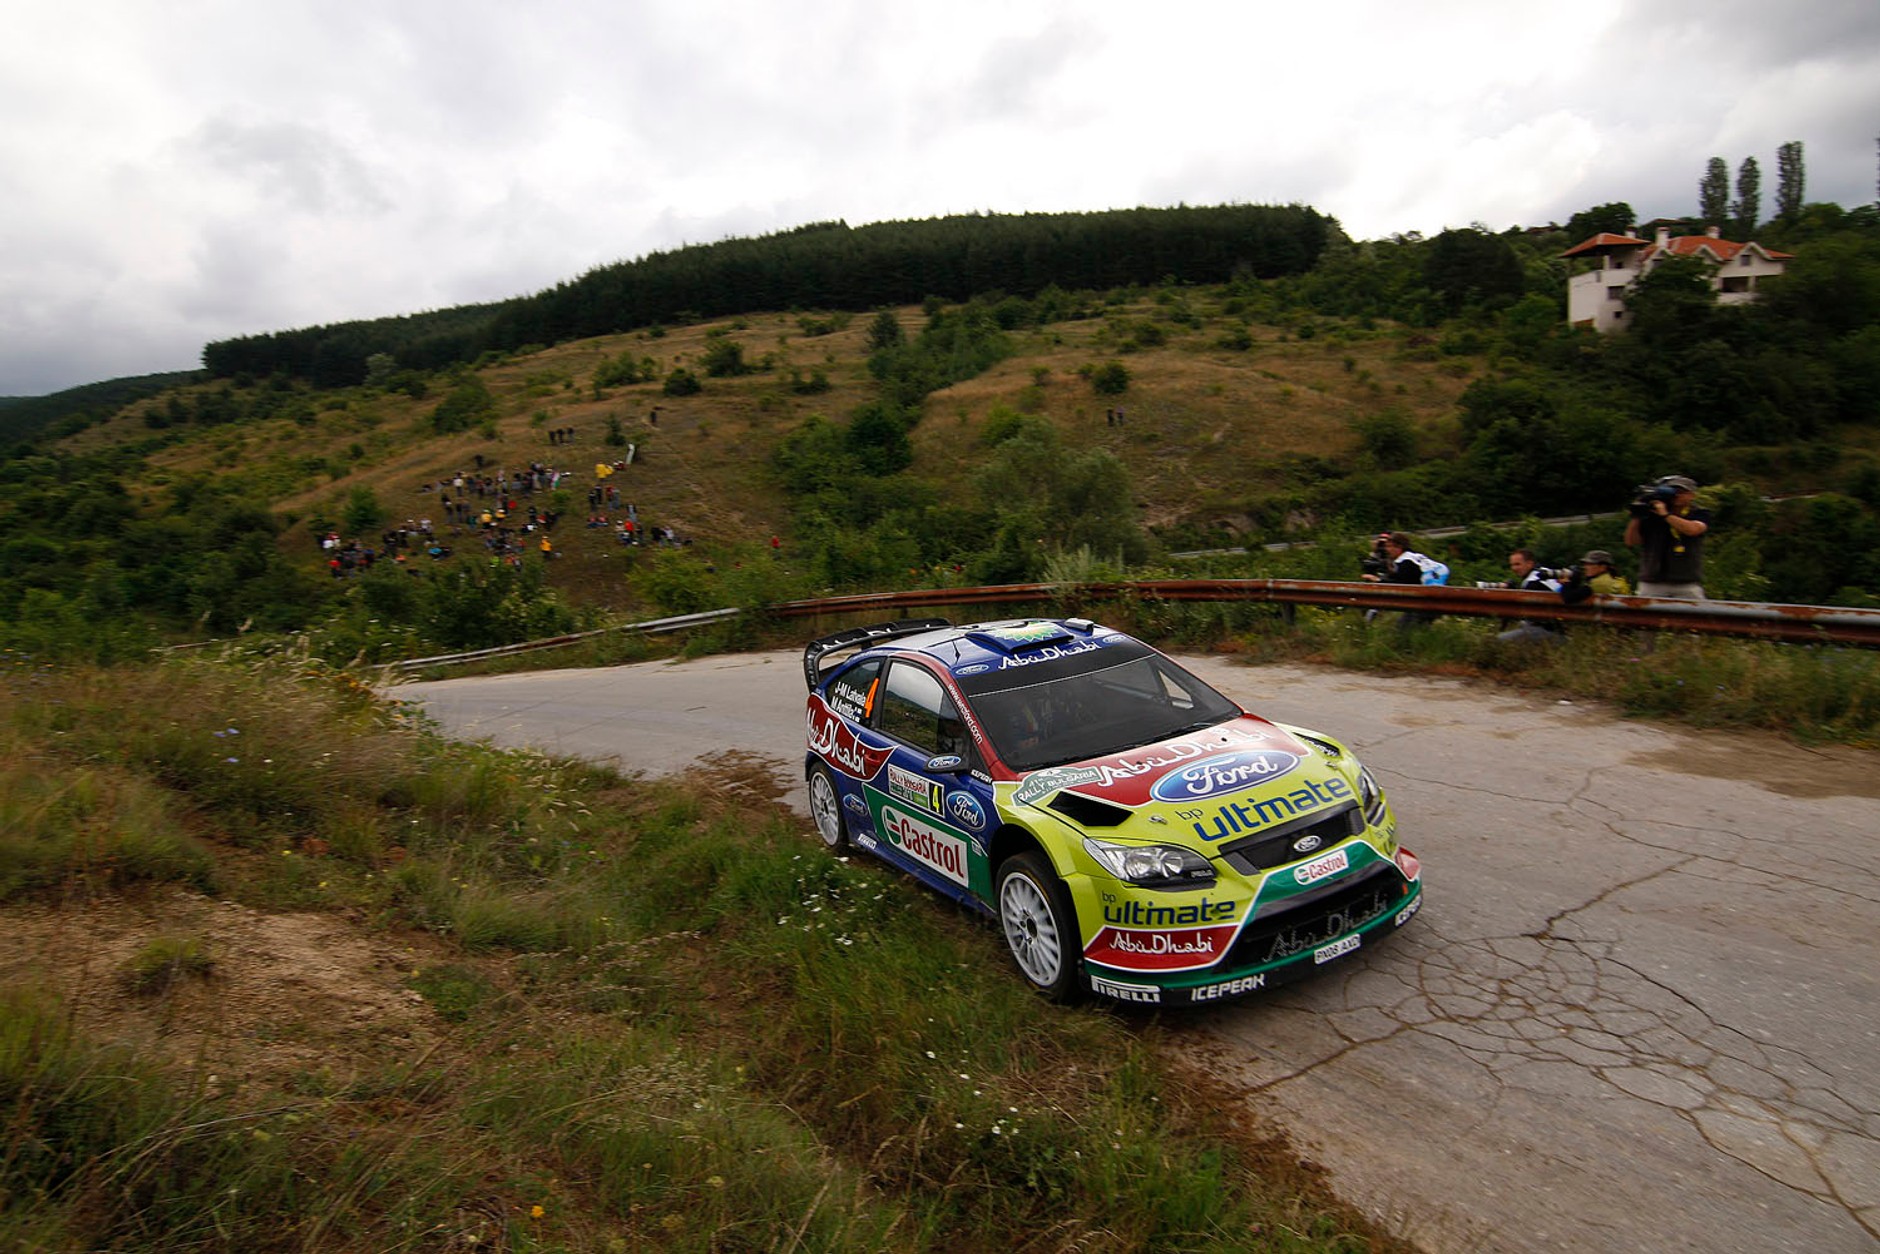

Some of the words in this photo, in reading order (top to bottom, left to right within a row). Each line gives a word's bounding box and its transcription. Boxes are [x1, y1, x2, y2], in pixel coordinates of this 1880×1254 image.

[863, 677, 880, 718] 4
[1017, 782, 1046, 802] RALLY
[1046, 770, 1098, 787] BULGARIA
[1182, 755, 1278, 795] Ford
[932, 785, 940, 813] 4
[953, 795, 980, 827] Ford
[1192, 778, 1351, 842] ultimate
[1176, 808, 1204, 822] bp
[901, 818, 964, 878] Castrol
[1308, 853, 1346, 879] Castrol
[1102, 891, 1117, 903] bp
[1104, 897, 1236, 925] ultimate
[1090, 974, 1161, 1003] PIRELLI
[1191, 973, 1265, 1002] ICEPEAK
